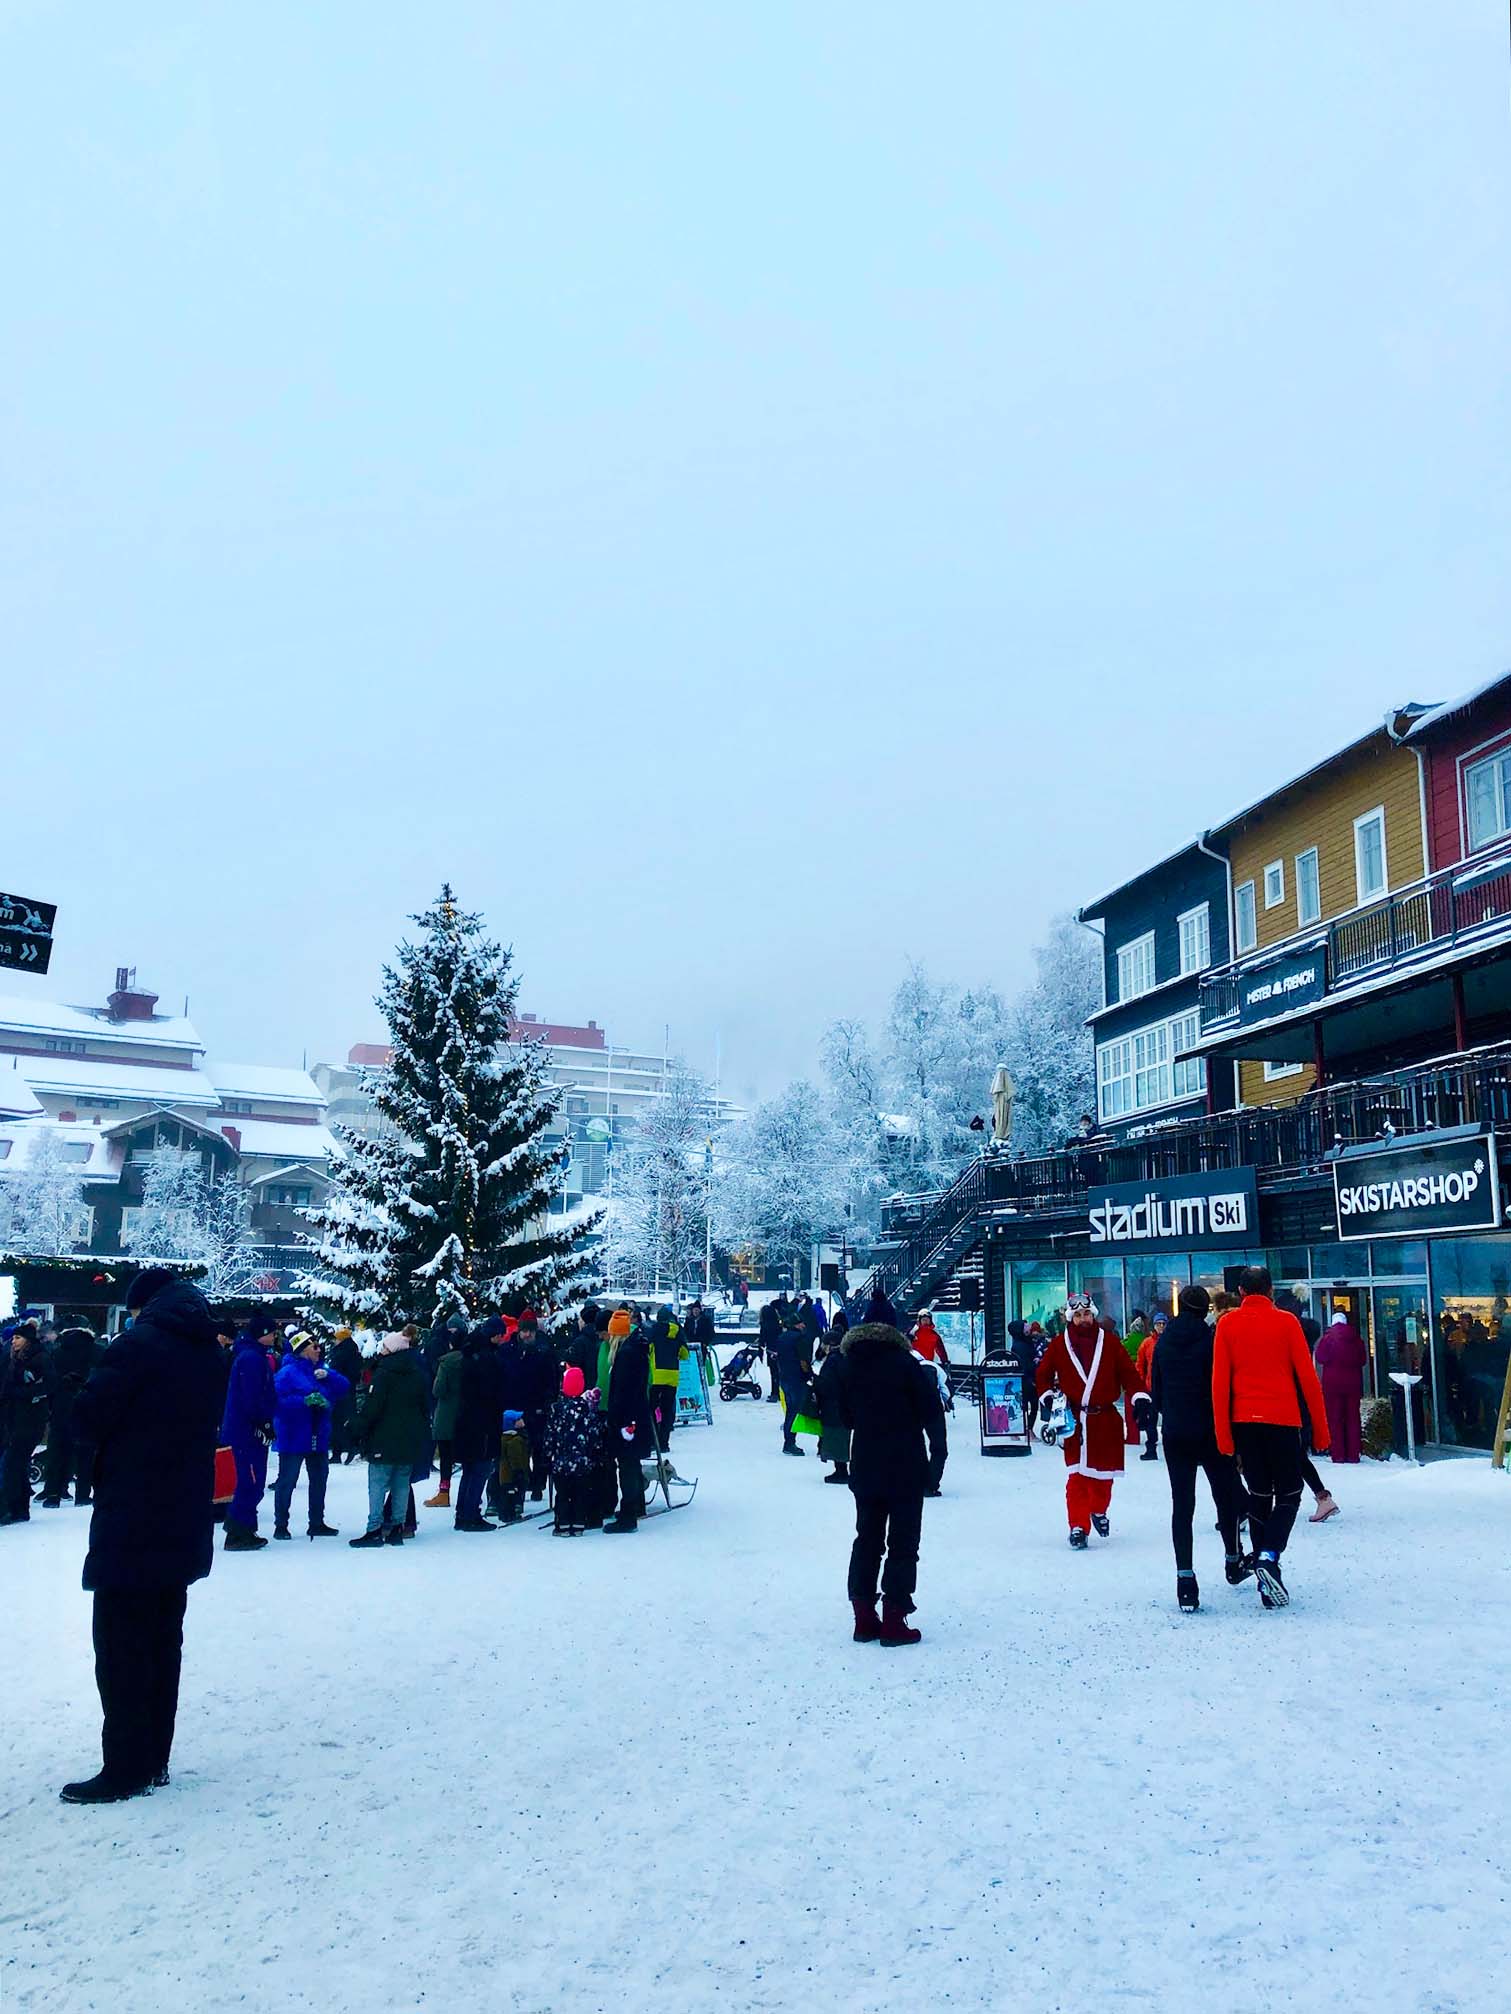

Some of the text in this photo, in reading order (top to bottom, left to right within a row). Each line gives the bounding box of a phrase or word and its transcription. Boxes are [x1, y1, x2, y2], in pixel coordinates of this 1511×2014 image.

[1246, 967, 1315, 1005] MISTER FRENCH
[1339, 1170, 1478, 1215] SKISTARSHOP
[1089, 1193, 1241, 1242] stadium Ski
[986, 1359, 1019, 1368] stadium
